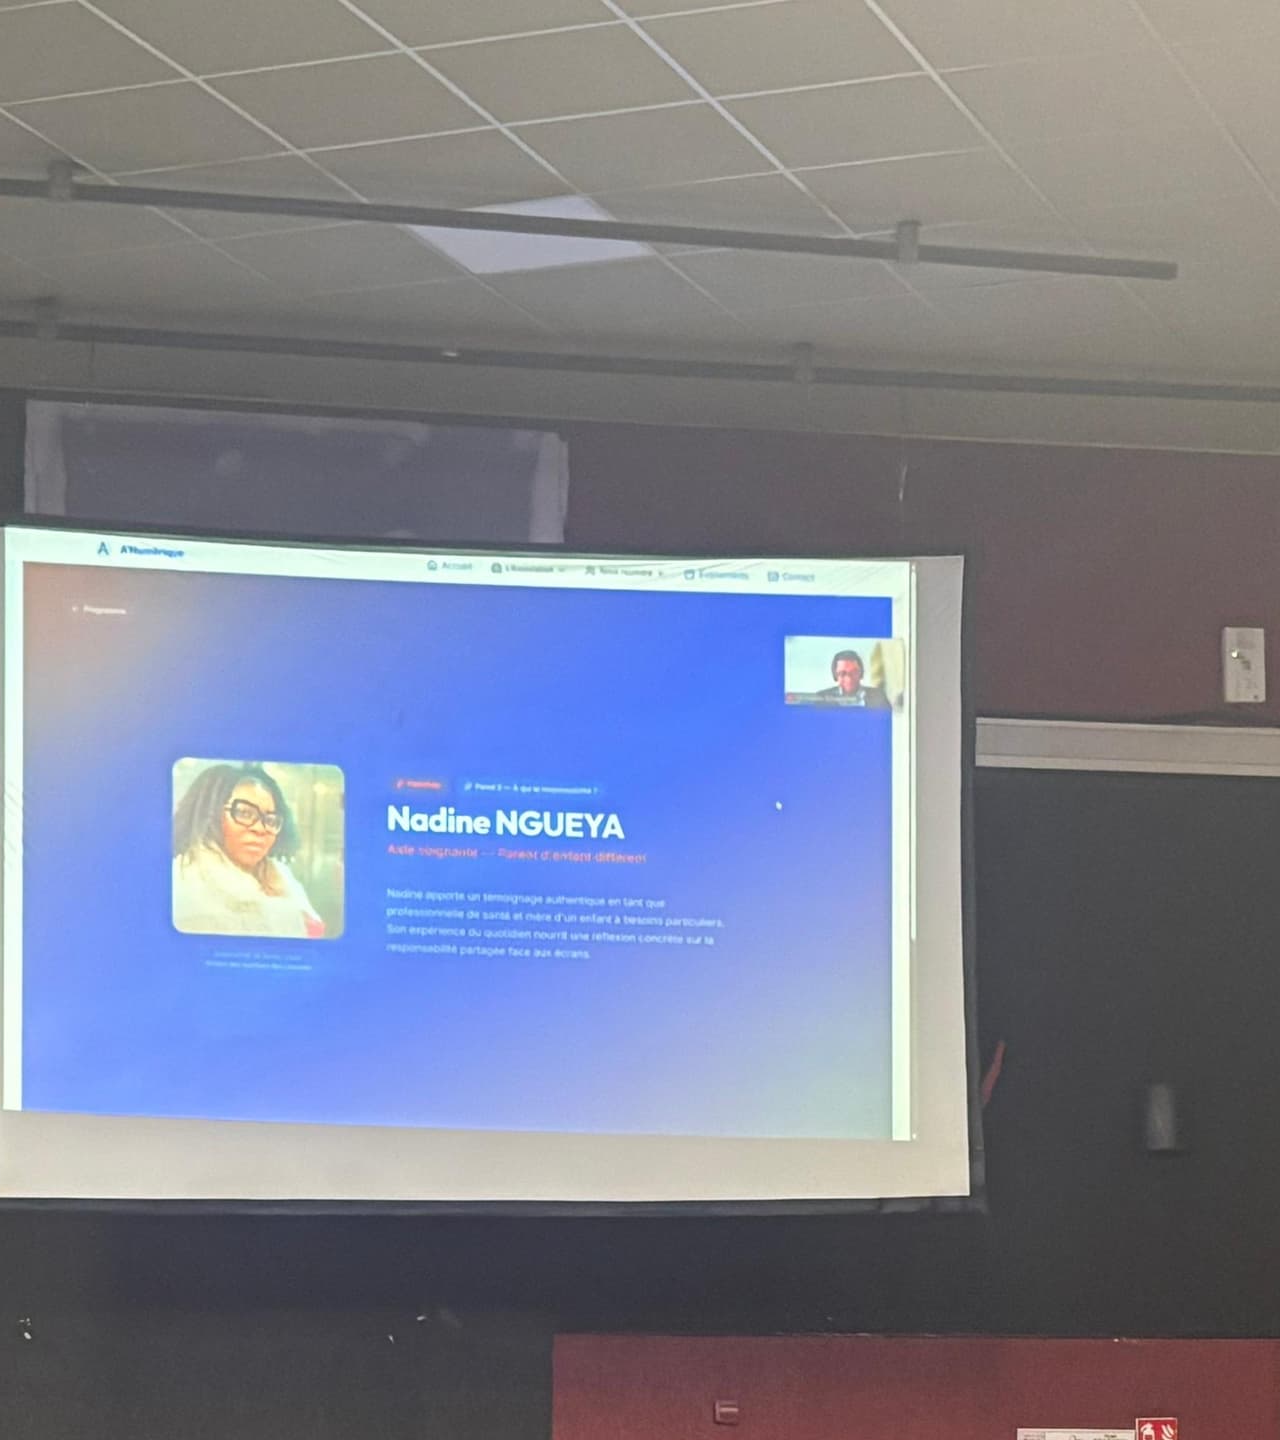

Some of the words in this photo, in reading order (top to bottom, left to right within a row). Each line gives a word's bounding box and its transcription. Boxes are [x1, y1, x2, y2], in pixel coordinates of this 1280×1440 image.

[387, 804, 491, 835] Nadine
[496, 809, 626, 840] NGUEYA
[387, 888, 423, 900] Nadine
[425, 890, 465, 903] apporte
[467, 892, 481, 901] un
[546, 895, 606, 908] authentique
[608, 898, 621, 906] en
[623, 897, 643, 908] tant
[645, 899, 665, 910] que
[467, 910, 480, 920] de
[554, 913, 577, 923] d'un
[580, 914, 612, 925] enfant
[387, 924, 407, 934] Son
[468, 927, 482, 937] du
[484, 928, 532, 940] quotidien
[570, 932, 590, 941] une
